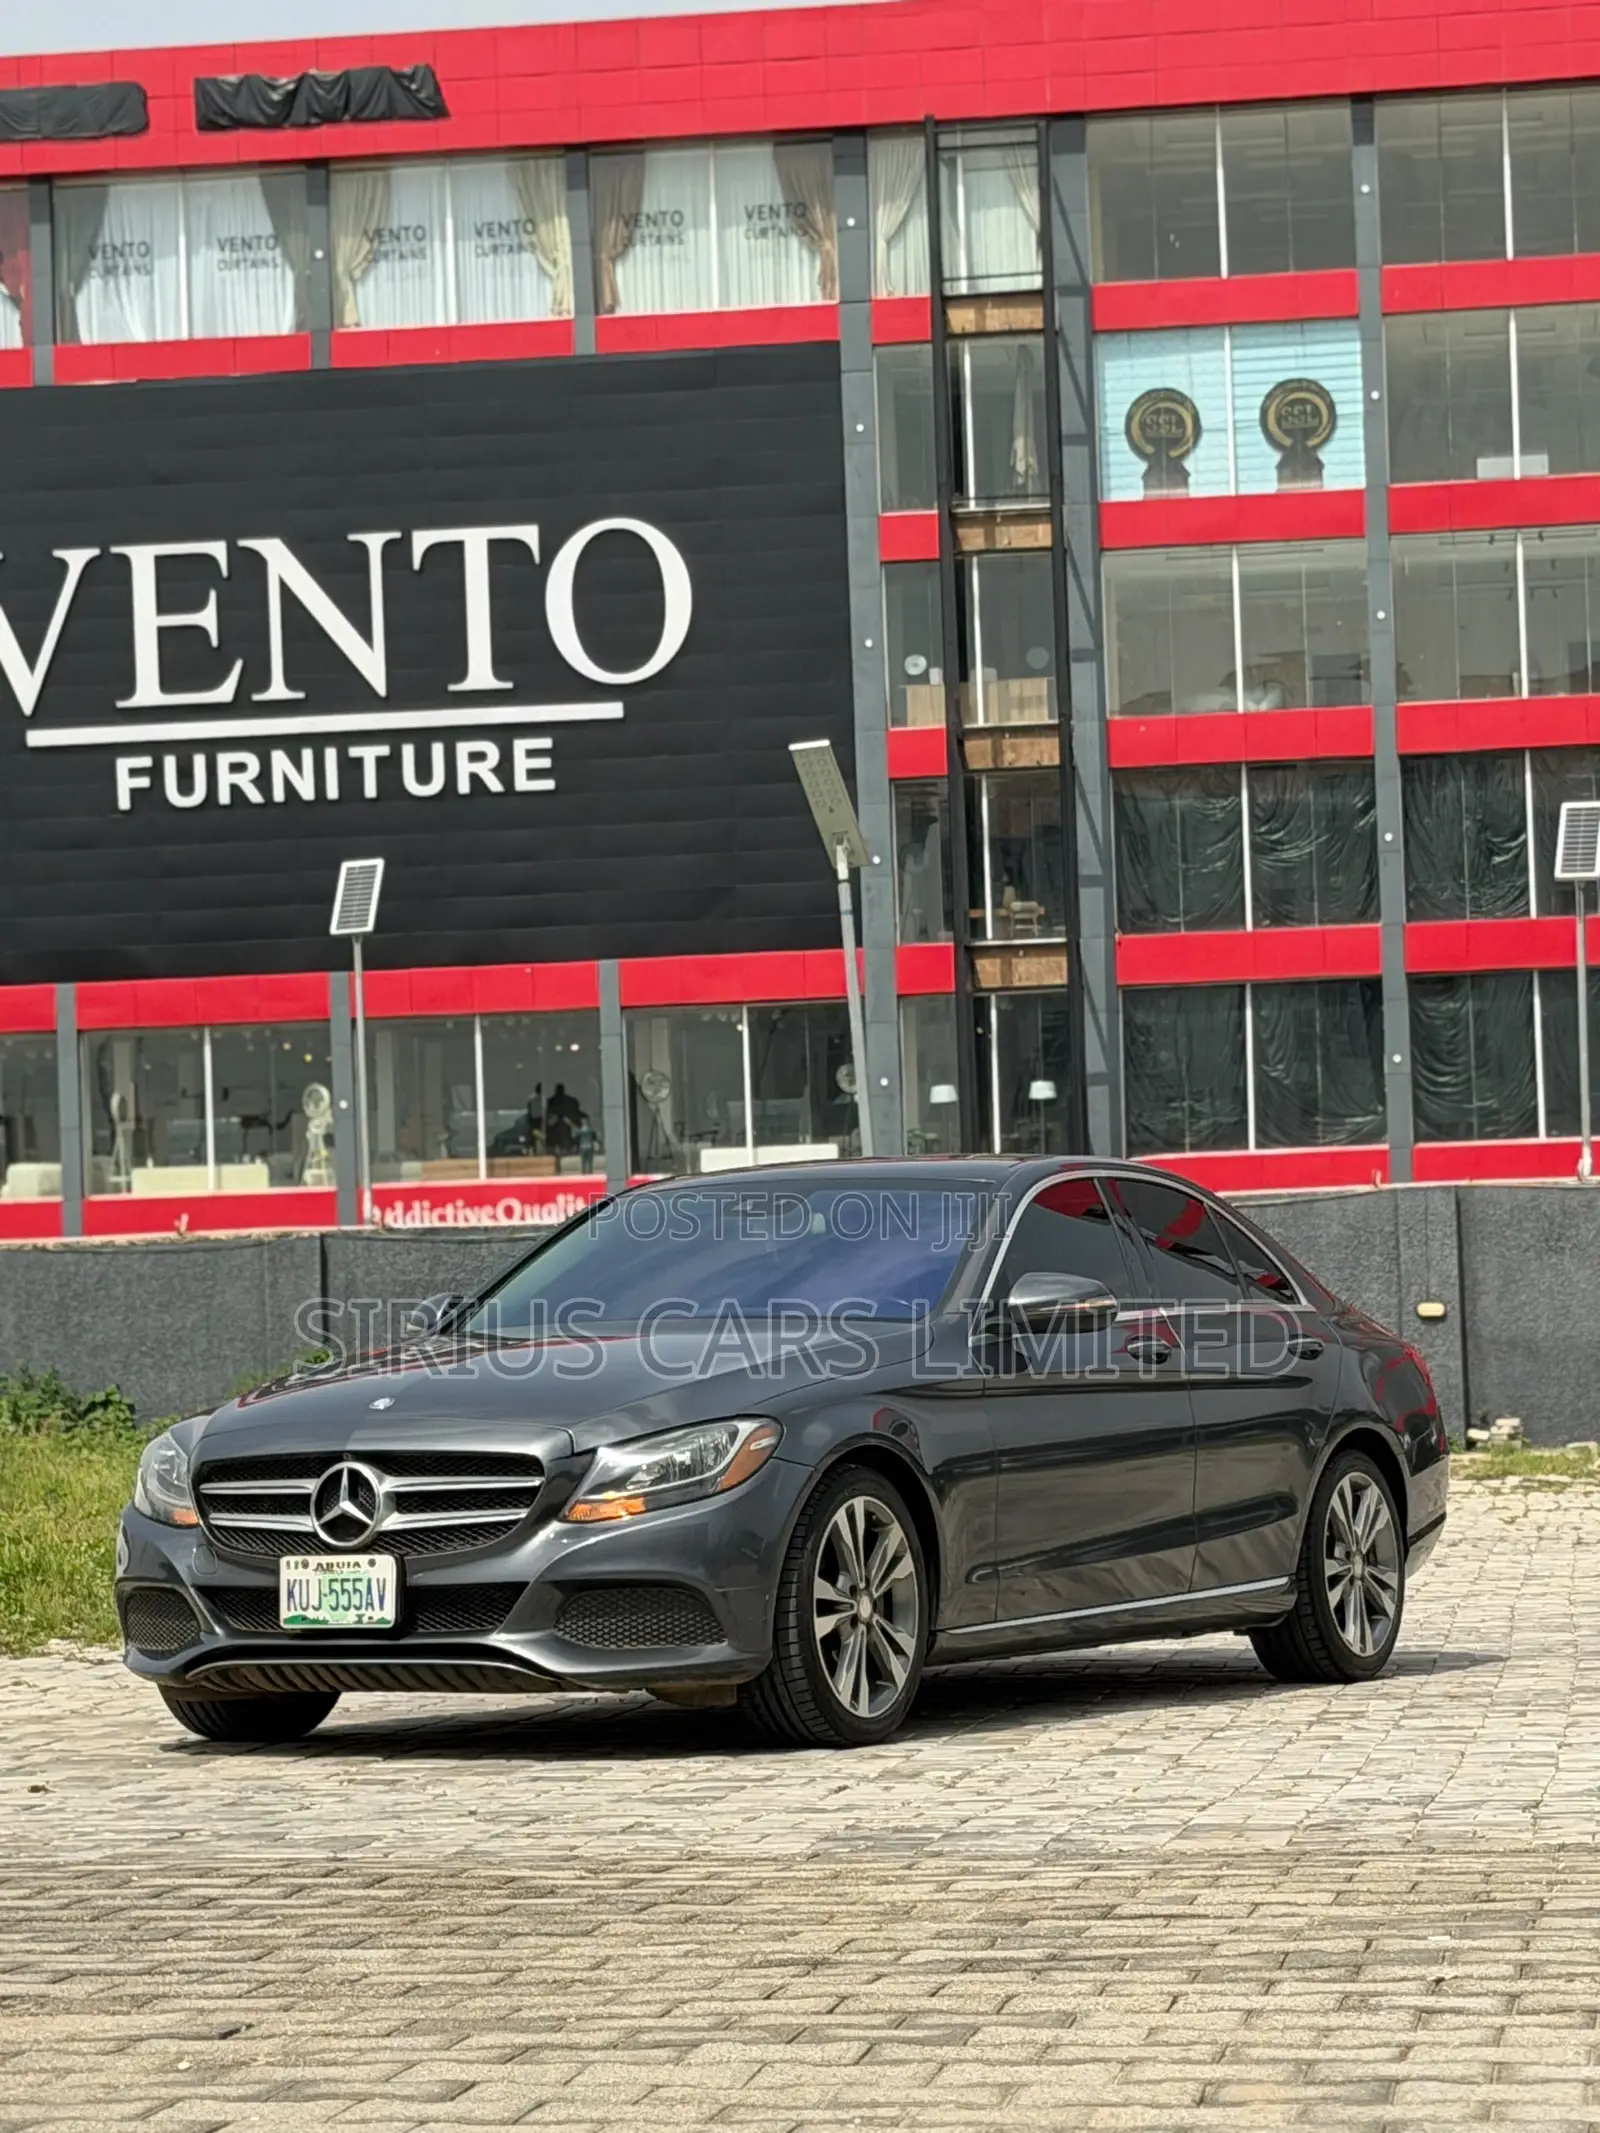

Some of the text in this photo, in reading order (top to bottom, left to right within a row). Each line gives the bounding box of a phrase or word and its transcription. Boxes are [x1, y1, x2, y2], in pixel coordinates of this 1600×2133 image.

[621, 209, 685, 229] VENTO
[743, 202, 807, 222] VENTO
[363, 224, 427, 244] VENTO
[473, 218, 537, 238] VENTO
[88, 241, 151, 260] VENTO
[216, 234, 280, 253] VENTO
[1144, 413, 1184, 435] SSL
[1280, 403, 1320, 427] SSL
[0, 518, 693, 717] VENTO
[115, 737, 556, 811] FURNITURE
